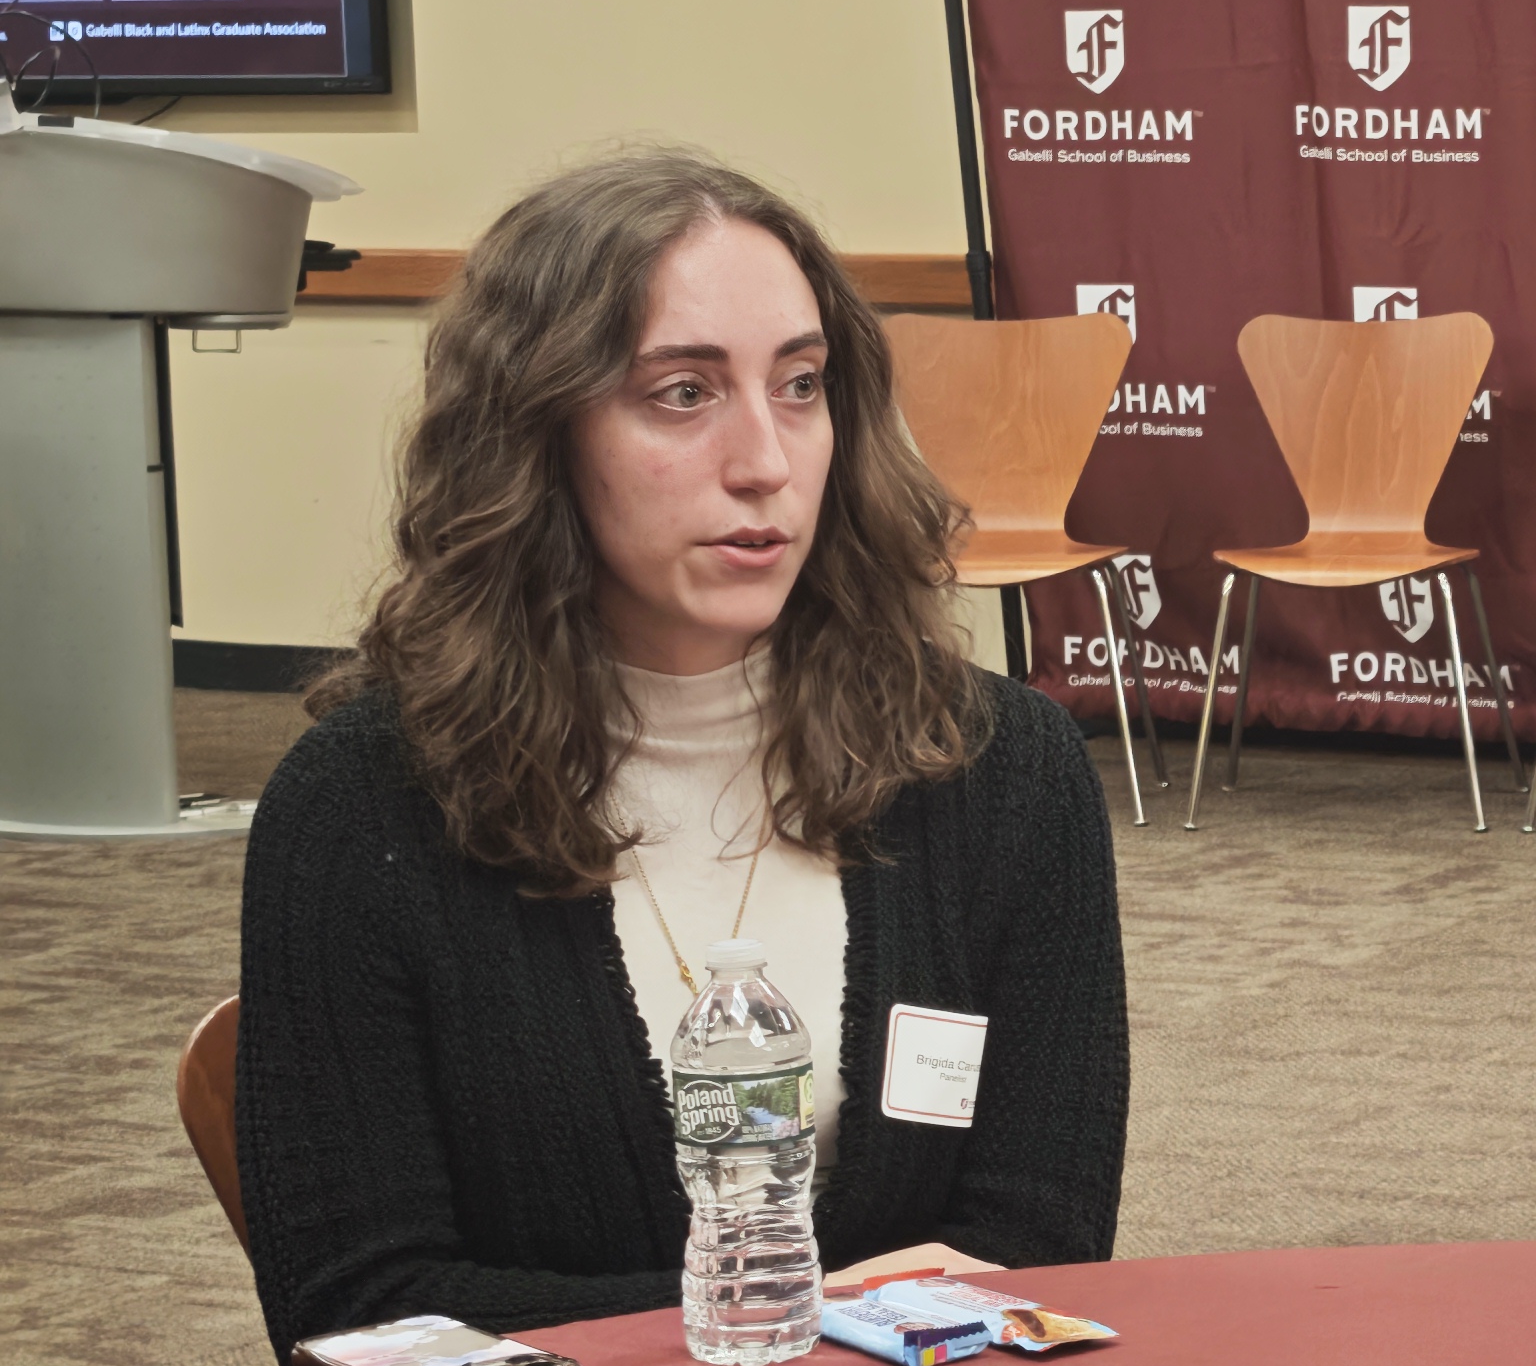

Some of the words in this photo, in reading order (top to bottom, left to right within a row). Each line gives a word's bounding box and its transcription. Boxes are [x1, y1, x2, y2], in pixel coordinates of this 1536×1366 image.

[1004, 109, 1193, 141] FORDHAM
[1295, 105, 1483, 139] FORDHAM
[1008, 147, 1054, 162] Gabelli
[1057, 149, 1108, 163] School
[1109, 149, 1125, 163] of
[1127, 149, 1192, 163] Business
[1336, 146, 1389, 162] School
[1391, 148, 1408, 162] of
[1412, 149, 1480, 163] Business
[1124, 422, 1138, 435] of
[1142, 422, 1203, 437] Business
[916, 1054, 954, 1069] Brigida
[677, 1082, 736, 1113] Poland
